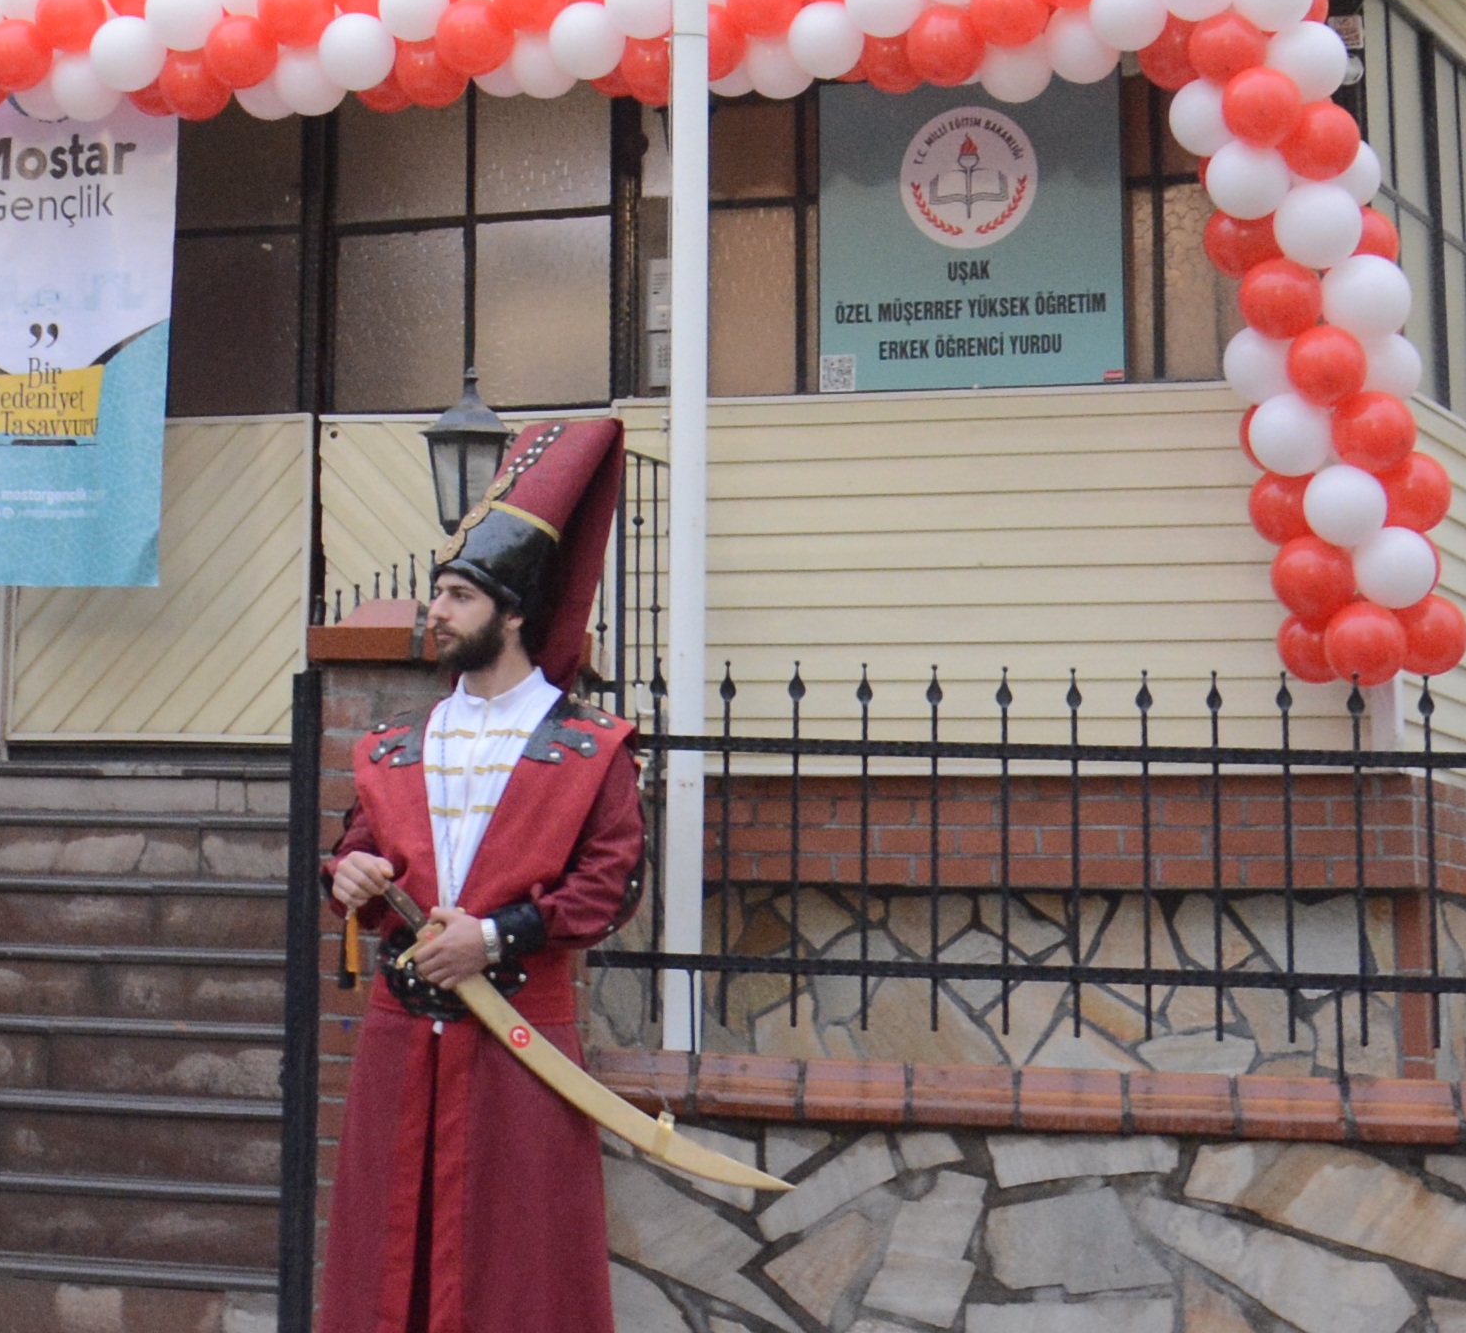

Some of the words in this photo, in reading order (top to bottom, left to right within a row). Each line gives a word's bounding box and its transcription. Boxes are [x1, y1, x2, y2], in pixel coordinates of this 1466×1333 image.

[947, 260, 990, 285] UŞAK
[835, 301, 873, 324] ÖZEL
[878, 298, 963, 325] MÜŞERREF
[968, 295, 1029, 318] YÜKSEK
[1035, 289, 1107, 315] ÖĞRETİM
[879, 339, 929, 360] ERKEK
[935, 332, 1004, 358] ÖĞRENCİ
[1009, 333, 1062, 355] YURDU
[28, 357, 62, 388] Bir
[2, 411, 99, 437] Tasavvuru
